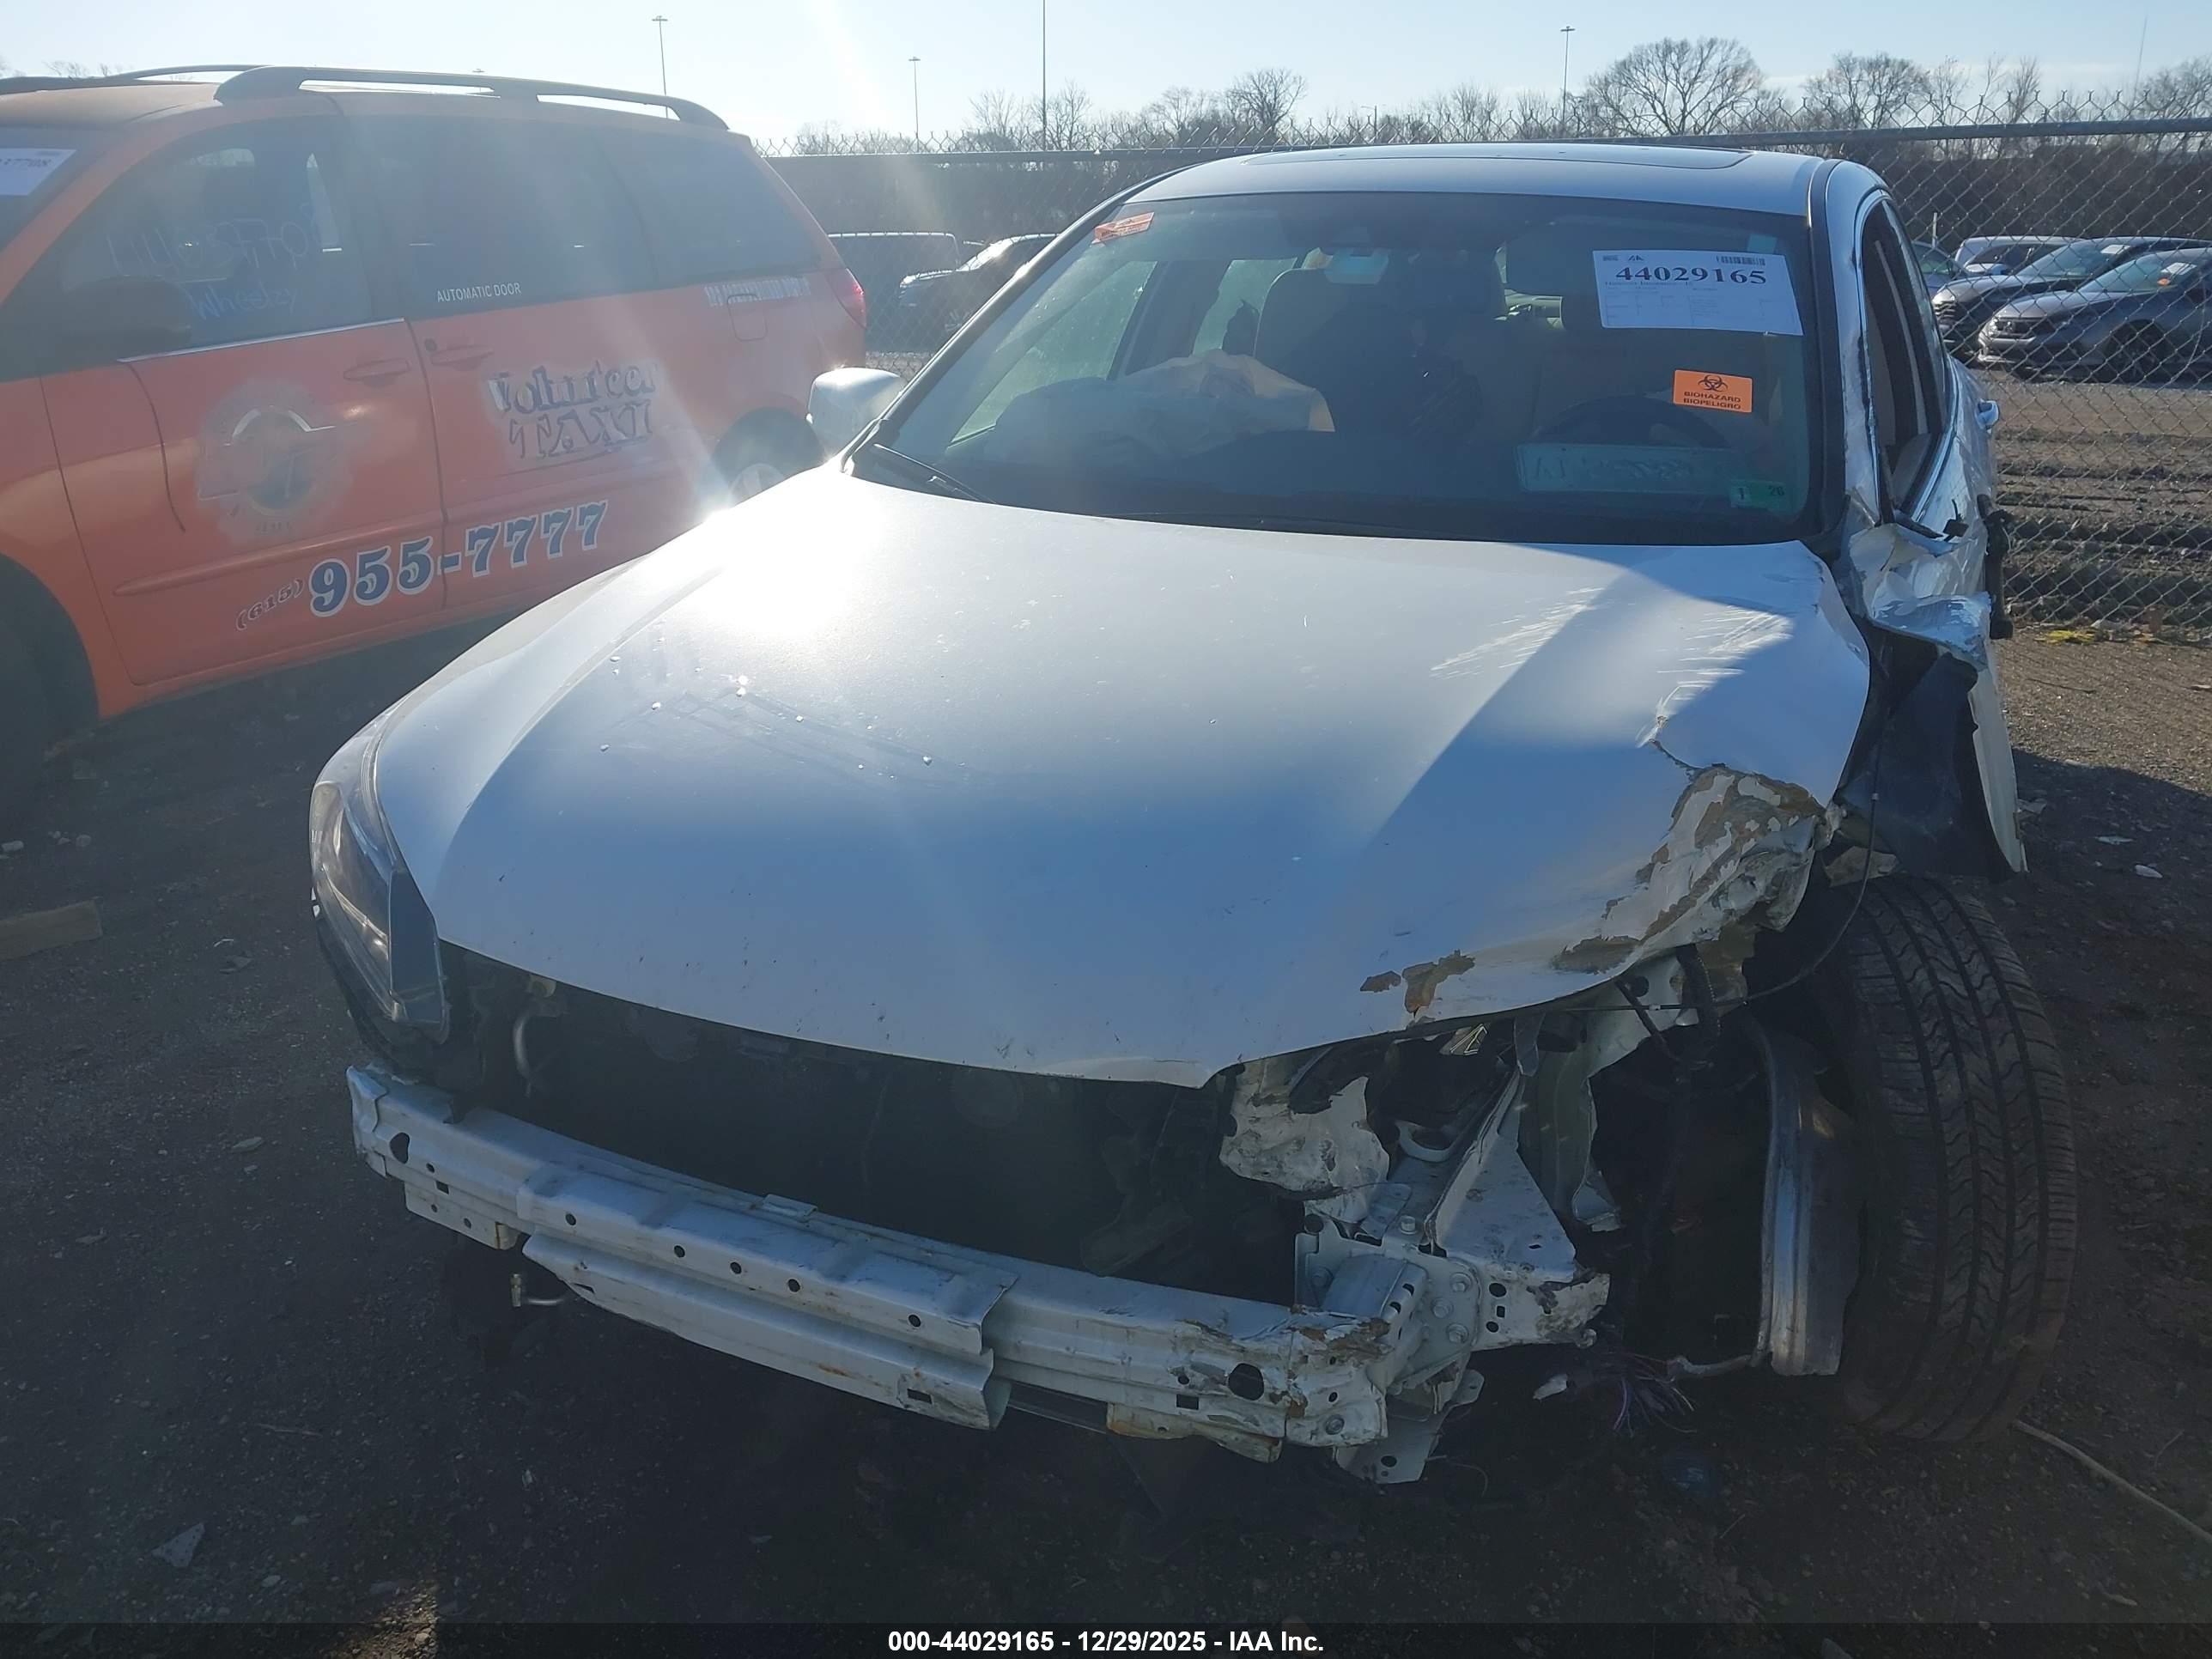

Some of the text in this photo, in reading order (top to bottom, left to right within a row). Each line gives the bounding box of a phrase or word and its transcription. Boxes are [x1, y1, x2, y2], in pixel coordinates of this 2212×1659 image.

[1615, 266, 1767, 285] 44029165
[437, 282, 522, 302] AUTOMATIC DOOR
[1683, 398, 1741, 410] BIOPELIGRO
[1684, 391, 1741, 403] BIOHAZARD
[235, 499, 609, 631] (615) 955-7777
